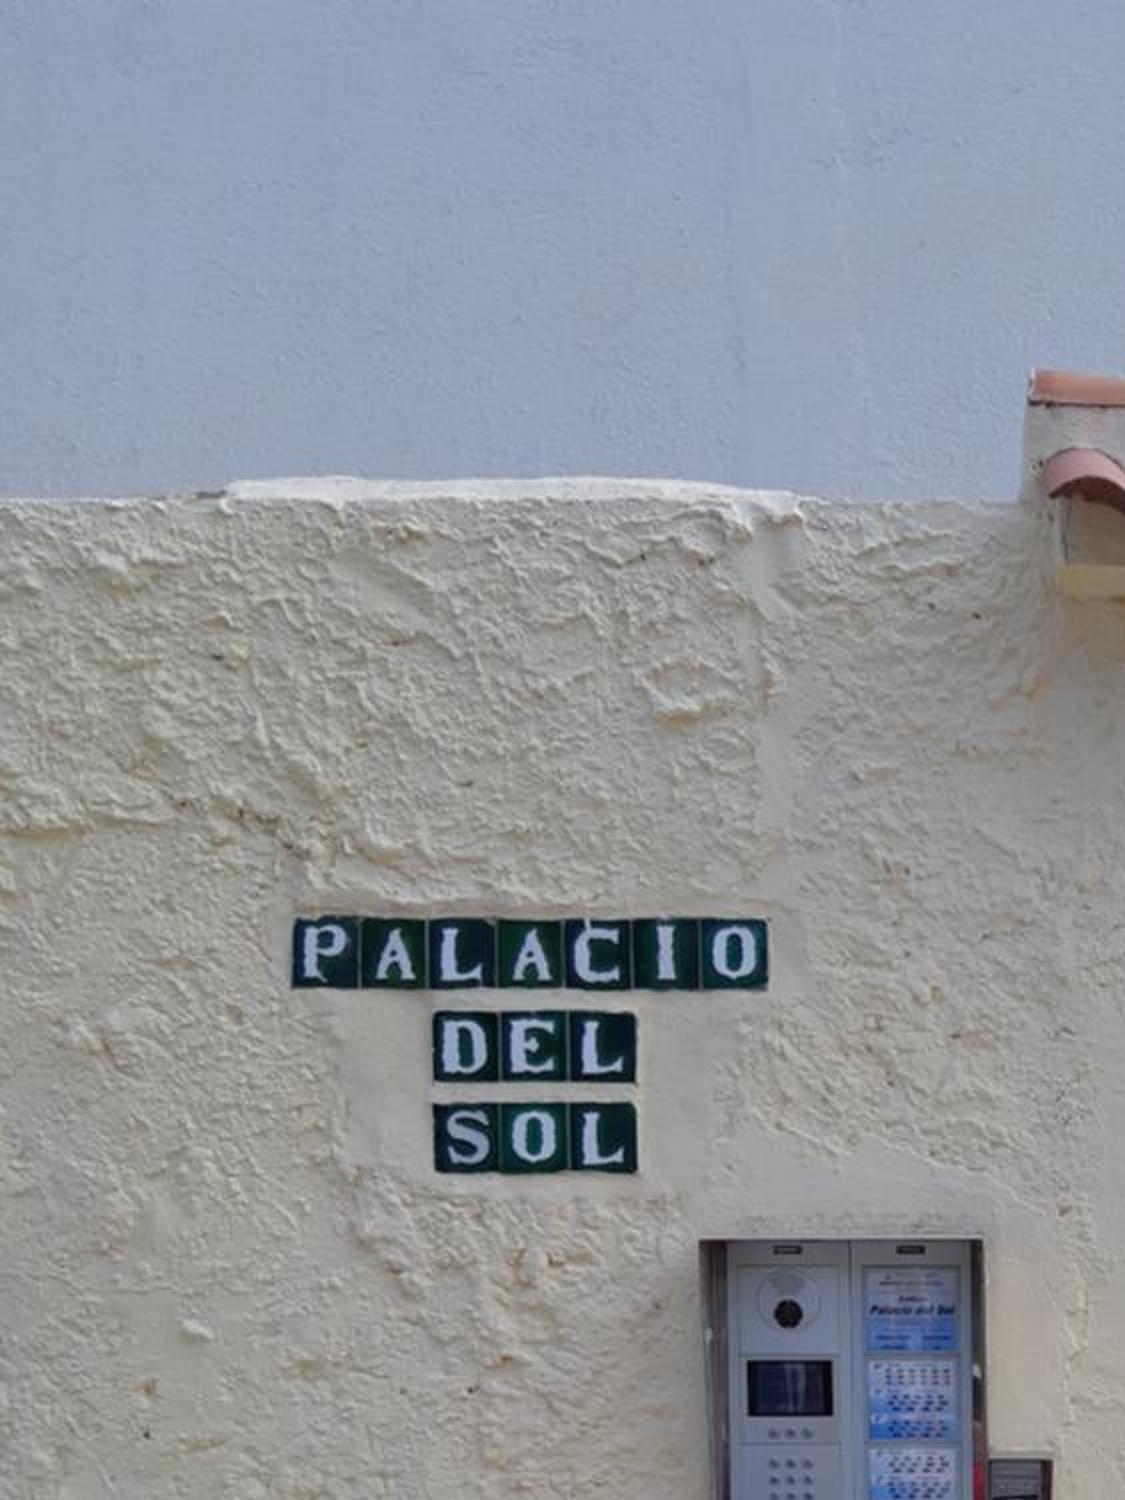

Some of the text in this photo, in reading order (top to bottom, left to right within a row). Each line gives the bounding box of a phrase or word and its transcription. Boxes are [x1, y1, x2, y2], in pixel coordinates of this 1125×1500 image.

[302, 920, 758, 983] PALACIO
[442, 1018, 623, 1075] DEL
[446, 1110, 624, 1165] SOL
[869, 1304, 913, 1315] Palacio
